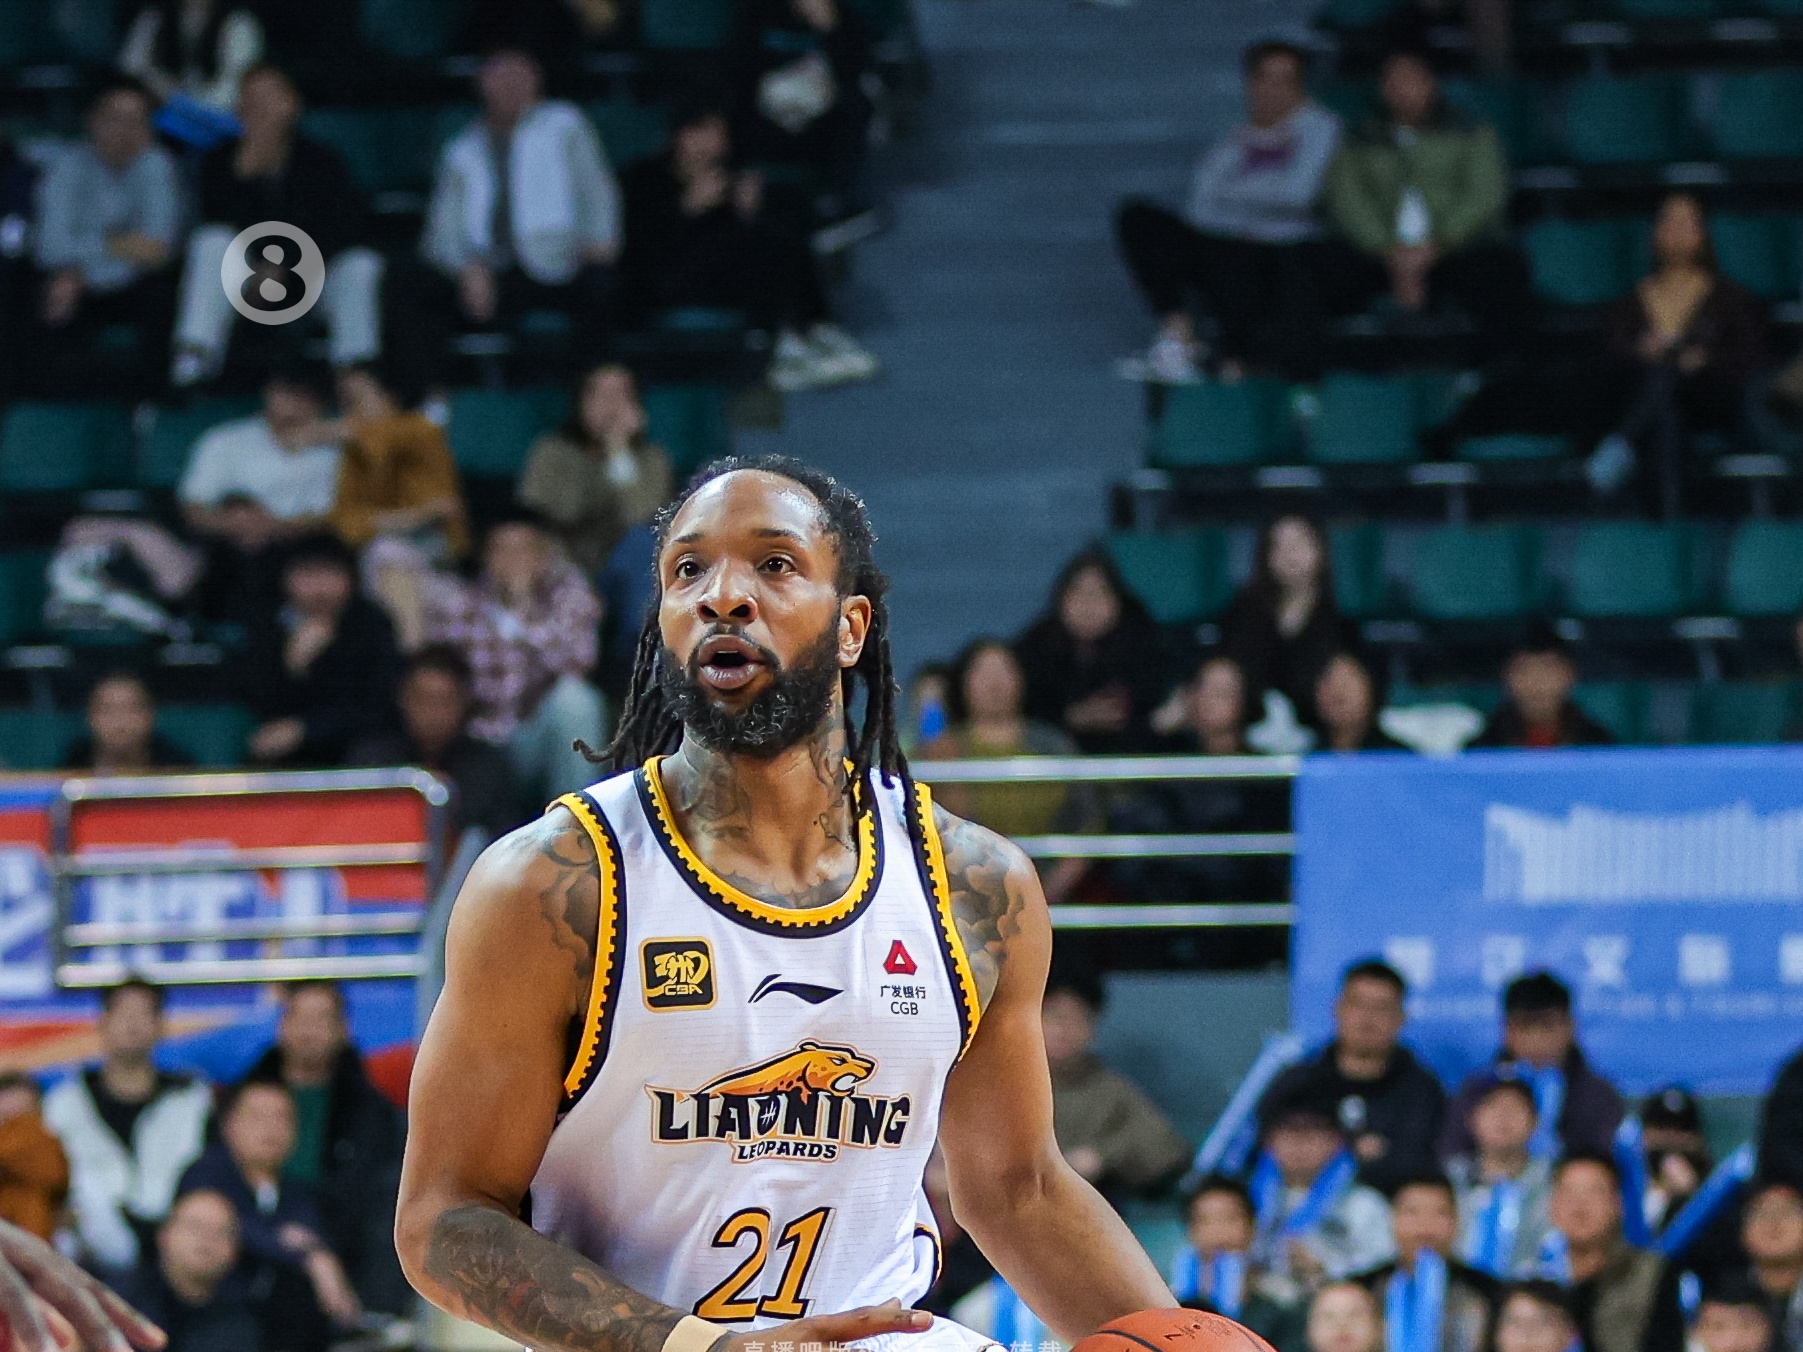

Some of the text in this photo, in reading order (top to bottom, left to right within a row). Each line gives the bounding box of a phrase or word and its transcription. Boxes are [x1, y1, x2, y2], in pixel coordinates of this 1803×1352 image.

[664, 984, 704, 996] CBA
[880, 984, 926, 999] 广发银行
[890, 1001, 919, 1015] CGB
[646, 1086, 911, 1147] LIAONING
[737, 1142, 838, 1161] LEOPARDS
[692, 1206, 834, 1323] 21
